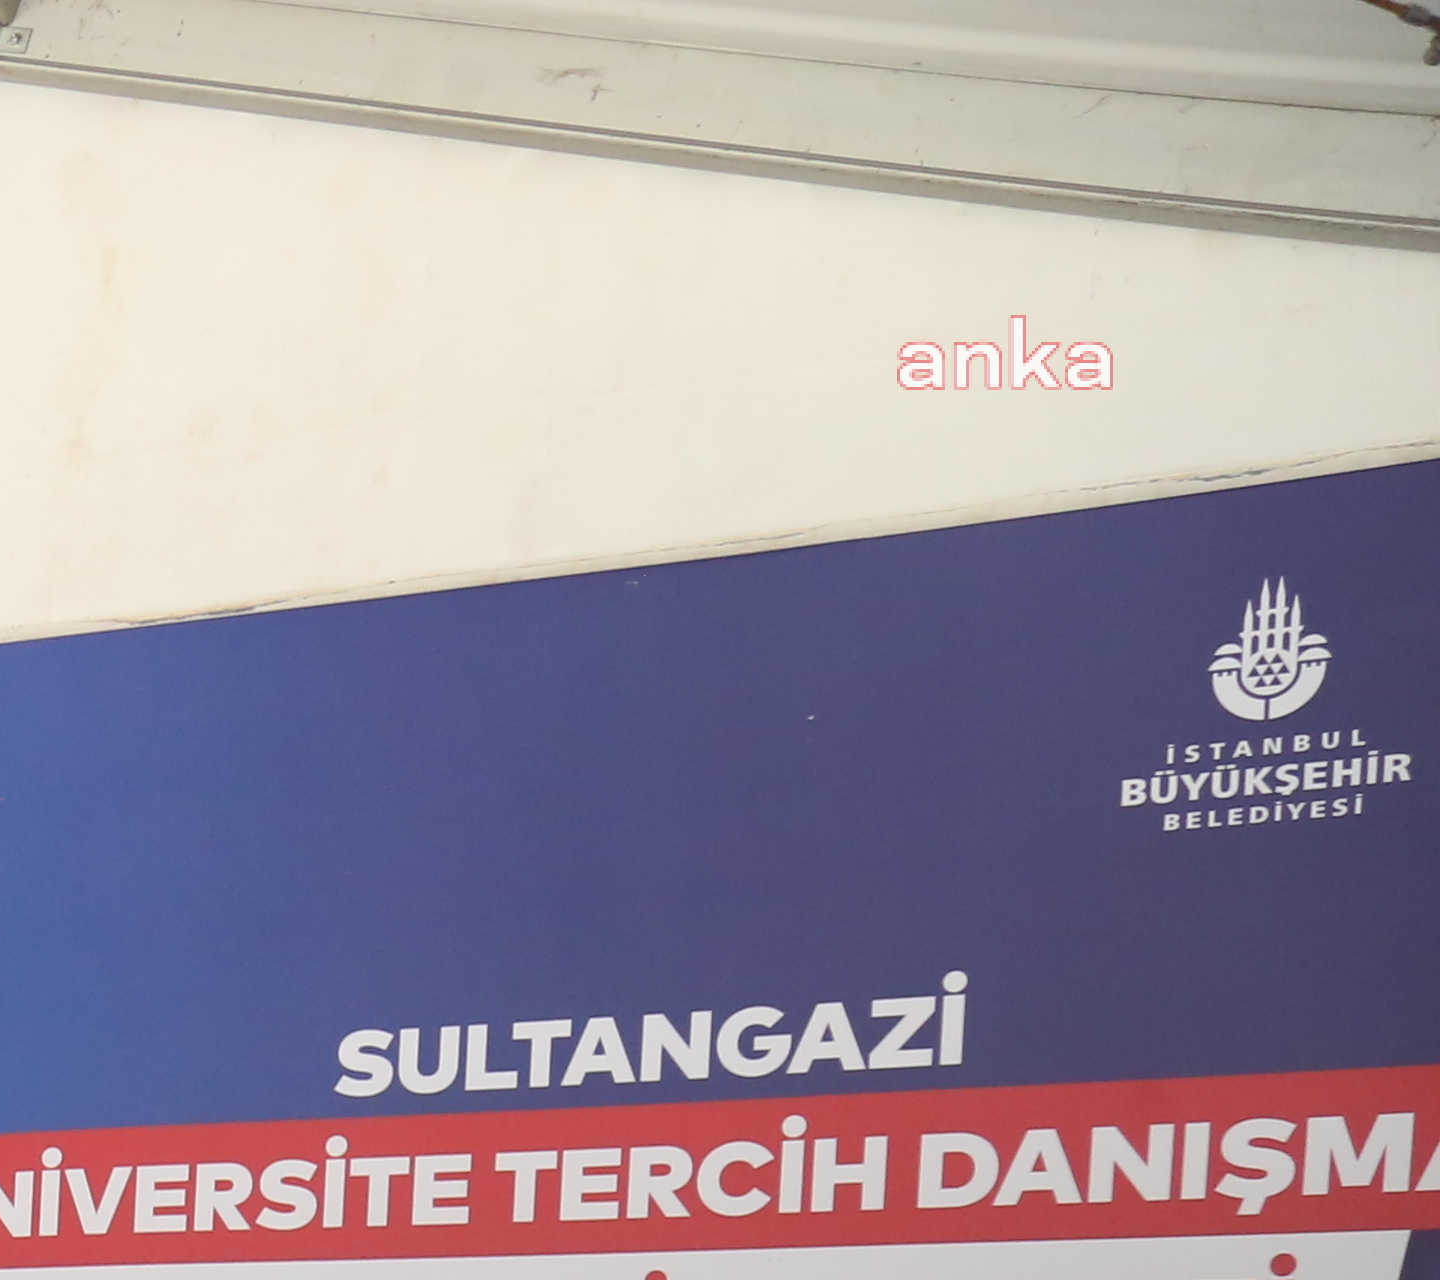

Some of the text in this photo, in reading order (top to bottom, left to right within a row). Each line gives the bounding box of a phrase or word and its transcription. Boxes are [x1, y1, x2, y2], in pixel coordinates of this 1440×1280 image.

[1166, 728, 1367, 765] İSTANBUL
[1120, 750, 1412, 808] BÜYÜKŞEHİR
[1163, 793, 1364, 832] BELEDİYESİ
[334, 969, 968, 1098] SULTANGAZİ
[494, 1114, 889, 1223] TERCİH
